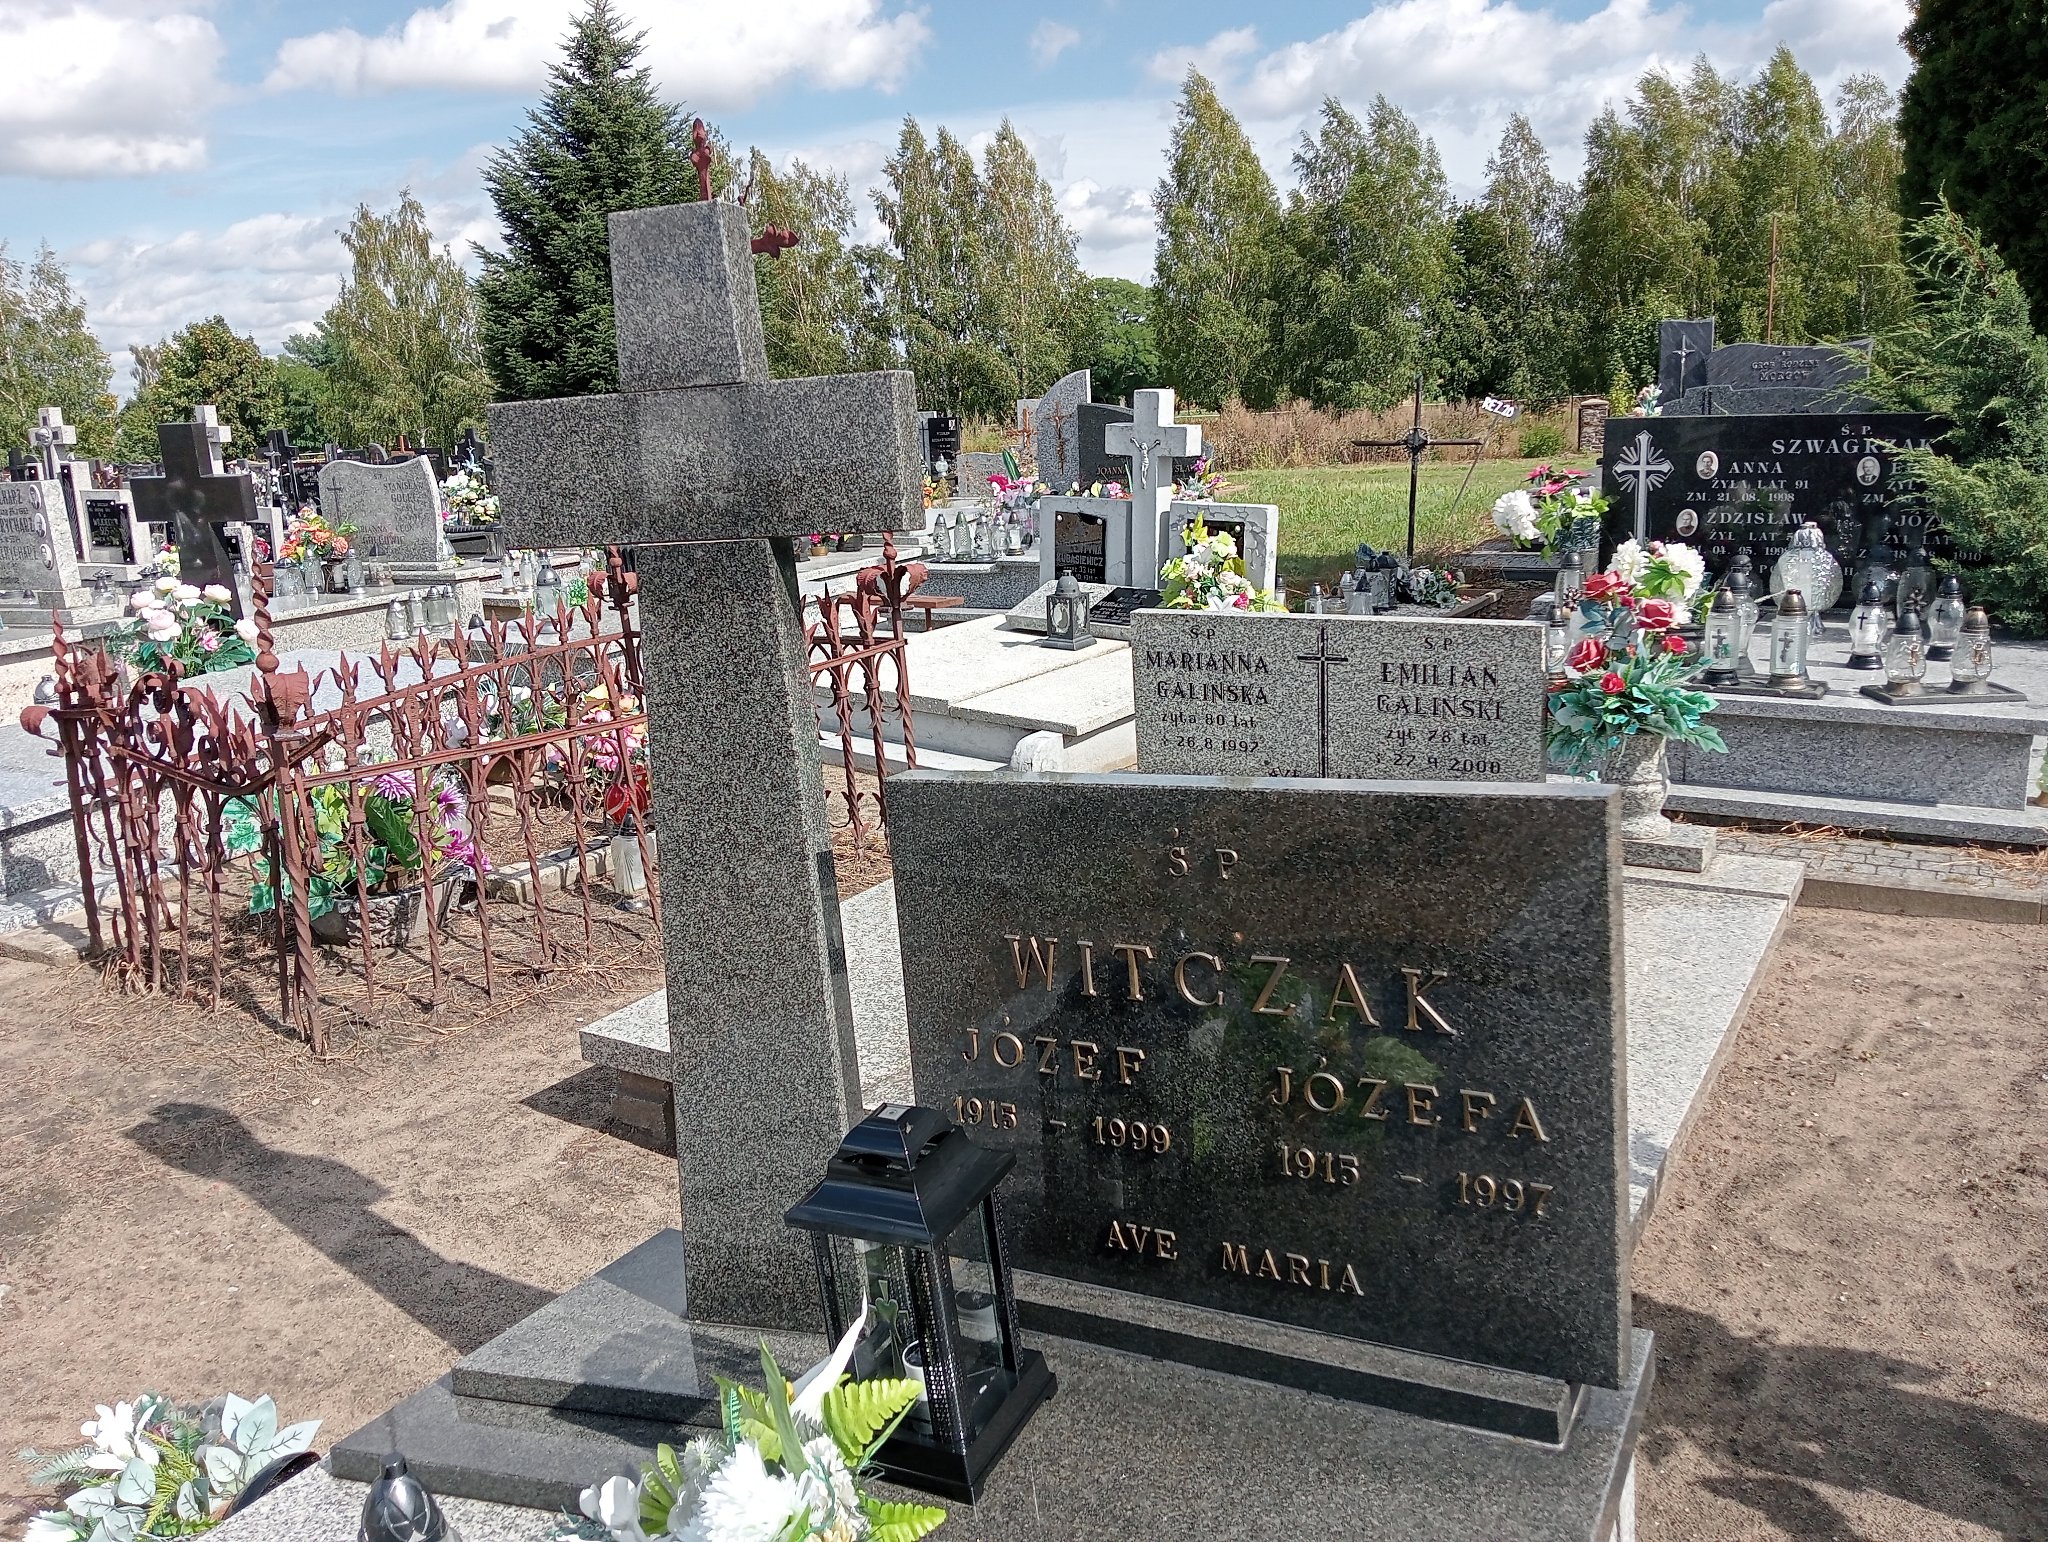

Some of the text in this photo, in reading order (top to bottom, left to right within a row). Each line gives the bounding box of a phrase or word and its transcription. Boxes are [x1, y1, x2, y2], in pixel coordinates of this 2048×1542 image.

[1861, 425, 1873, 436] P.
[1728, 461, 1784, 474] ANNA
[1757, 479, 1787, 489] LAT
[1795, 480, 1810, 489] 91
[1749, 531, 1778, 541] LAT
[1146, 650, 1269, 674] MARIANNA
[1381, 662, 1498, 690] EMILIAN
[1205, 713, 1225, 726] 80
[1176, 736, 1195, 748] 26
[1222, 740, 1259, 753] 1997
[1427, 730, 1452, 743] 78
[1393, 753, 1416, 767] 27
[1448, 758, 1501, 774] 2000
[1215, 847, 1240, 880] P
[1003, 932, 1458, 1037] WITCZAK
[960, 1014, 1147, 1087] JÓZEF
[1270, 1055, 1552, 1144] JÓZEFA
[951, 1094, 1019, 1131] 1915
[1093, 1115, 1173, 1156] 1999
[1278, 1143, 1361, 1187] 1915
[1455, 1170, 1557, 1219] 1997
[1107, 1218, 1366, 1298] AVE MARIA
